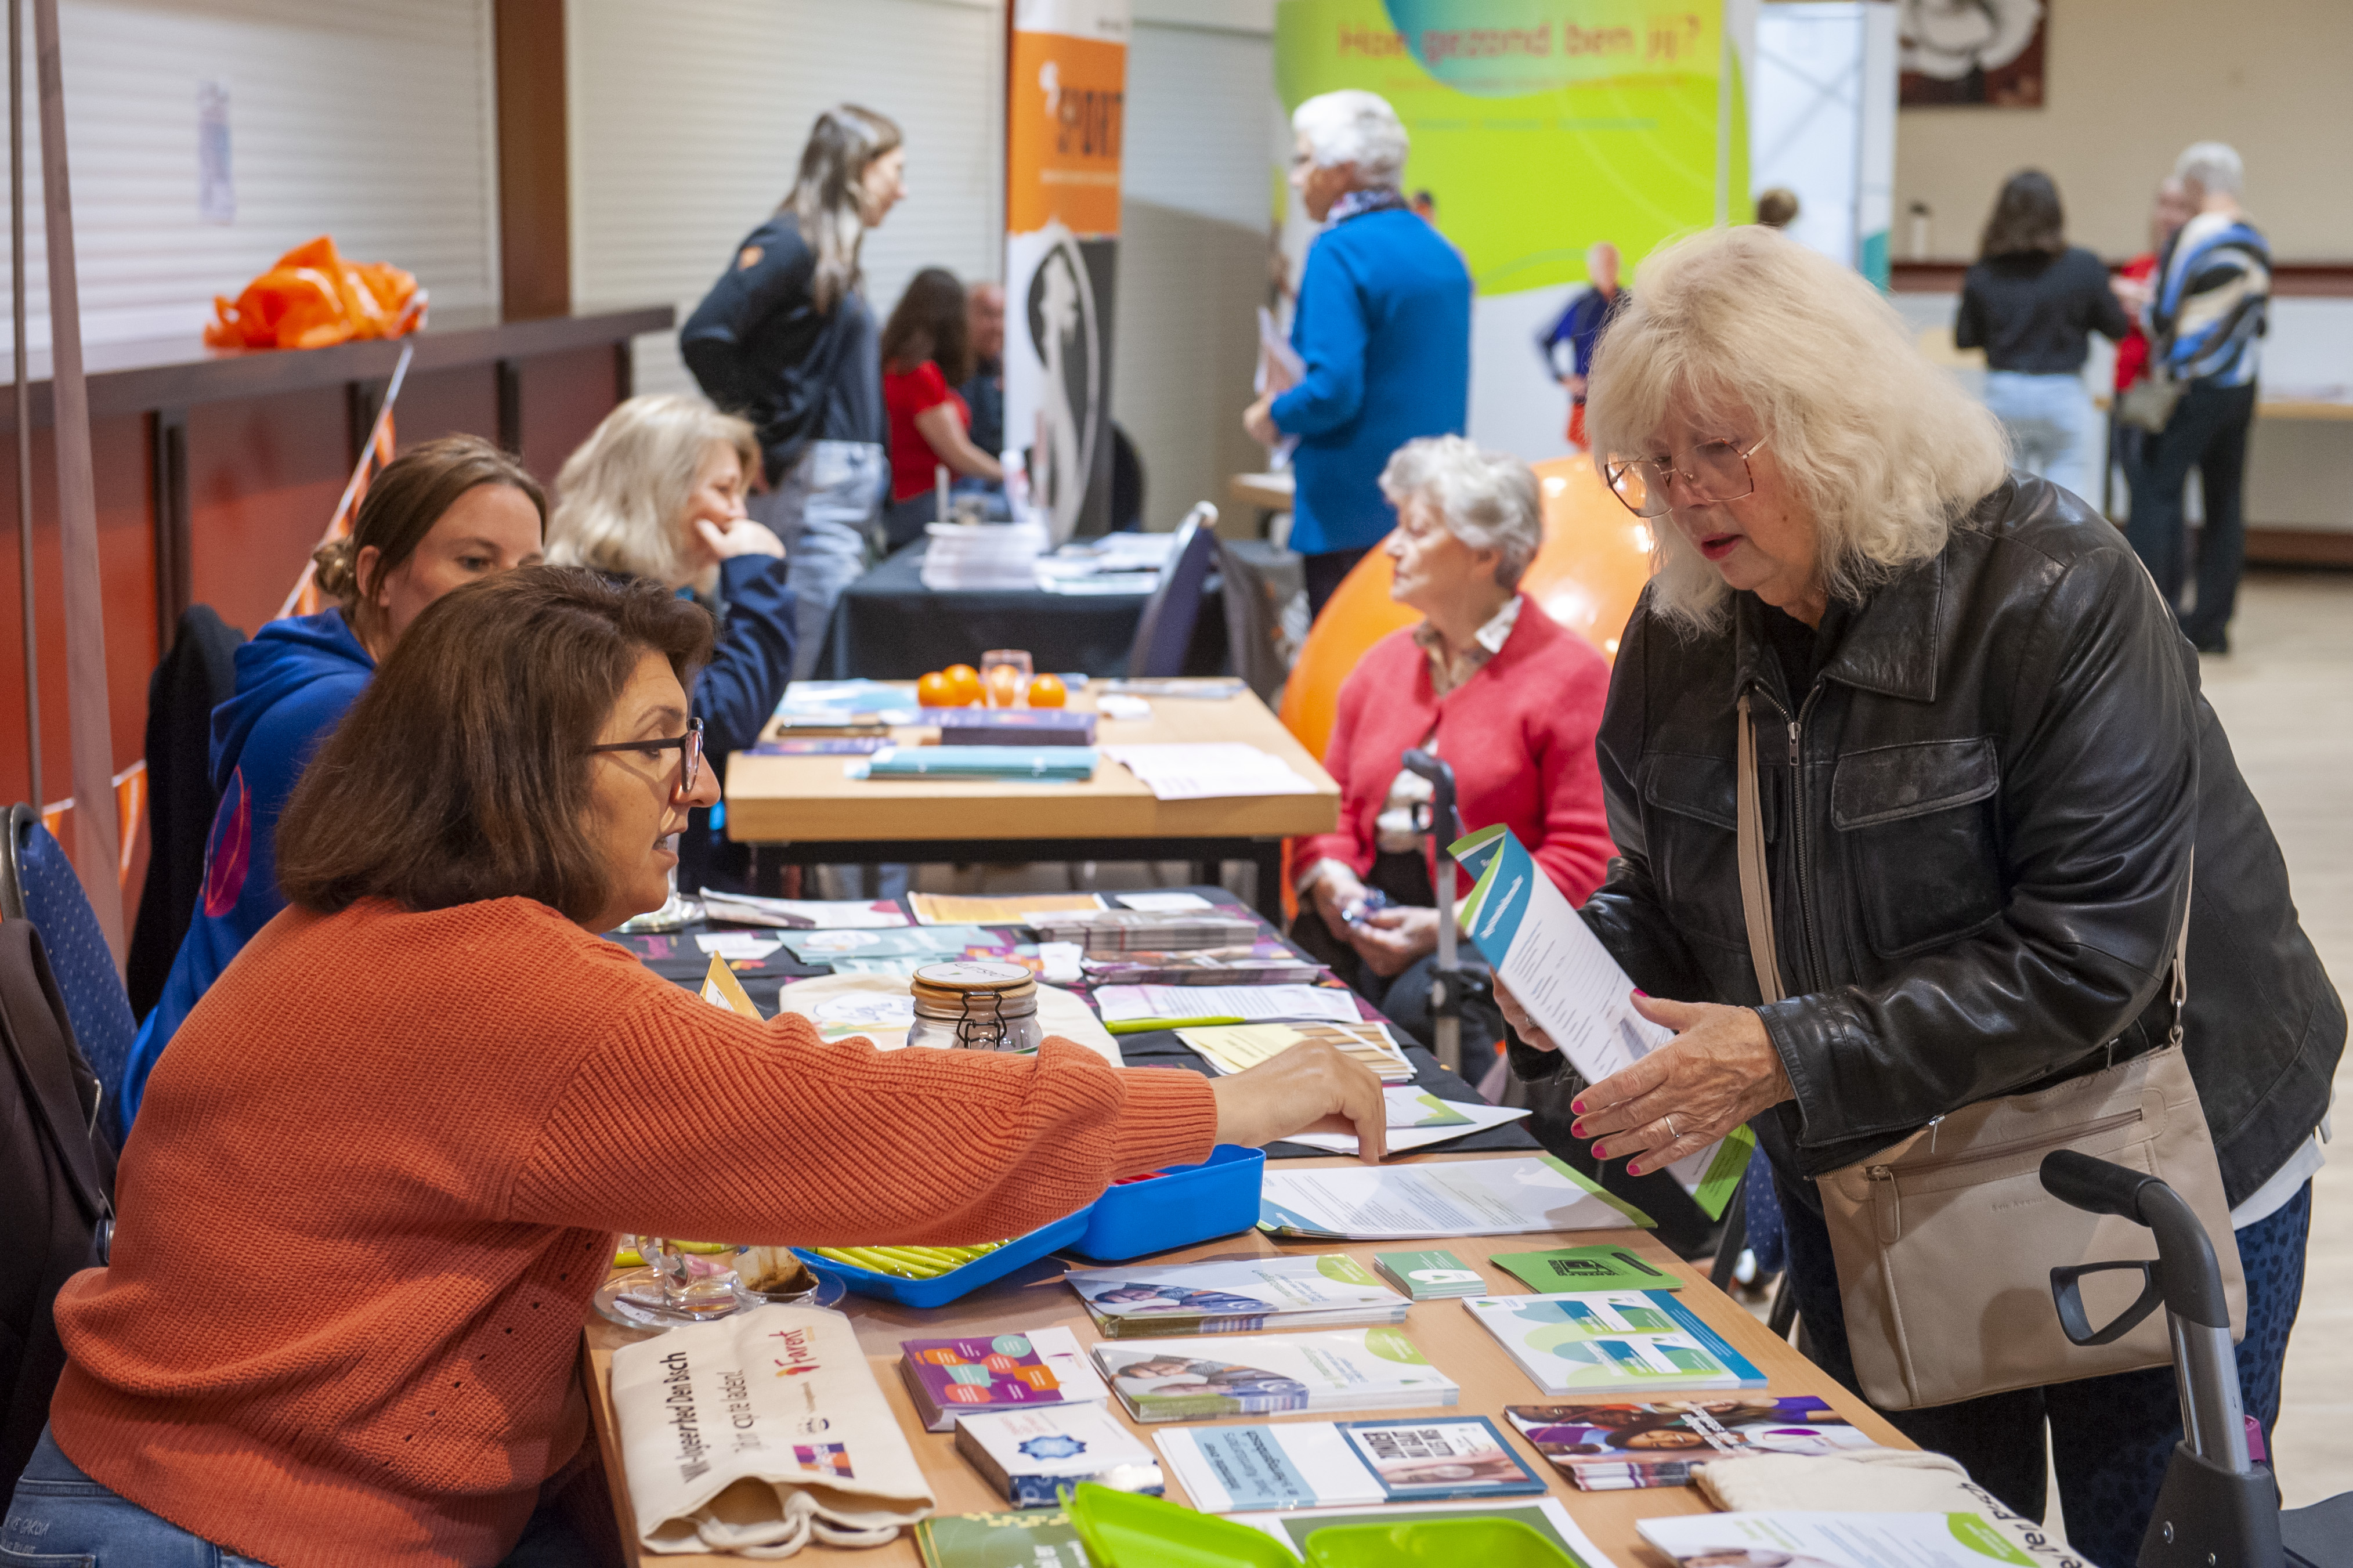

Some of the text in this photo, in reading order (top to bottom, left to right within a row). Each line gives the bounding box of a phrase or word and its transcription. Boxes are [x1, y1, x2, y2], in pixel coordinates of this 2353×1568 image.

[1422, 22, 1552, 64] gezond
[1565, 19, 1635, 57] ben
[768, 1328, 817, 1367] Farent
[665, 1383, 694, 1403] Den
[716, 1369, 749, 1402] laden!
